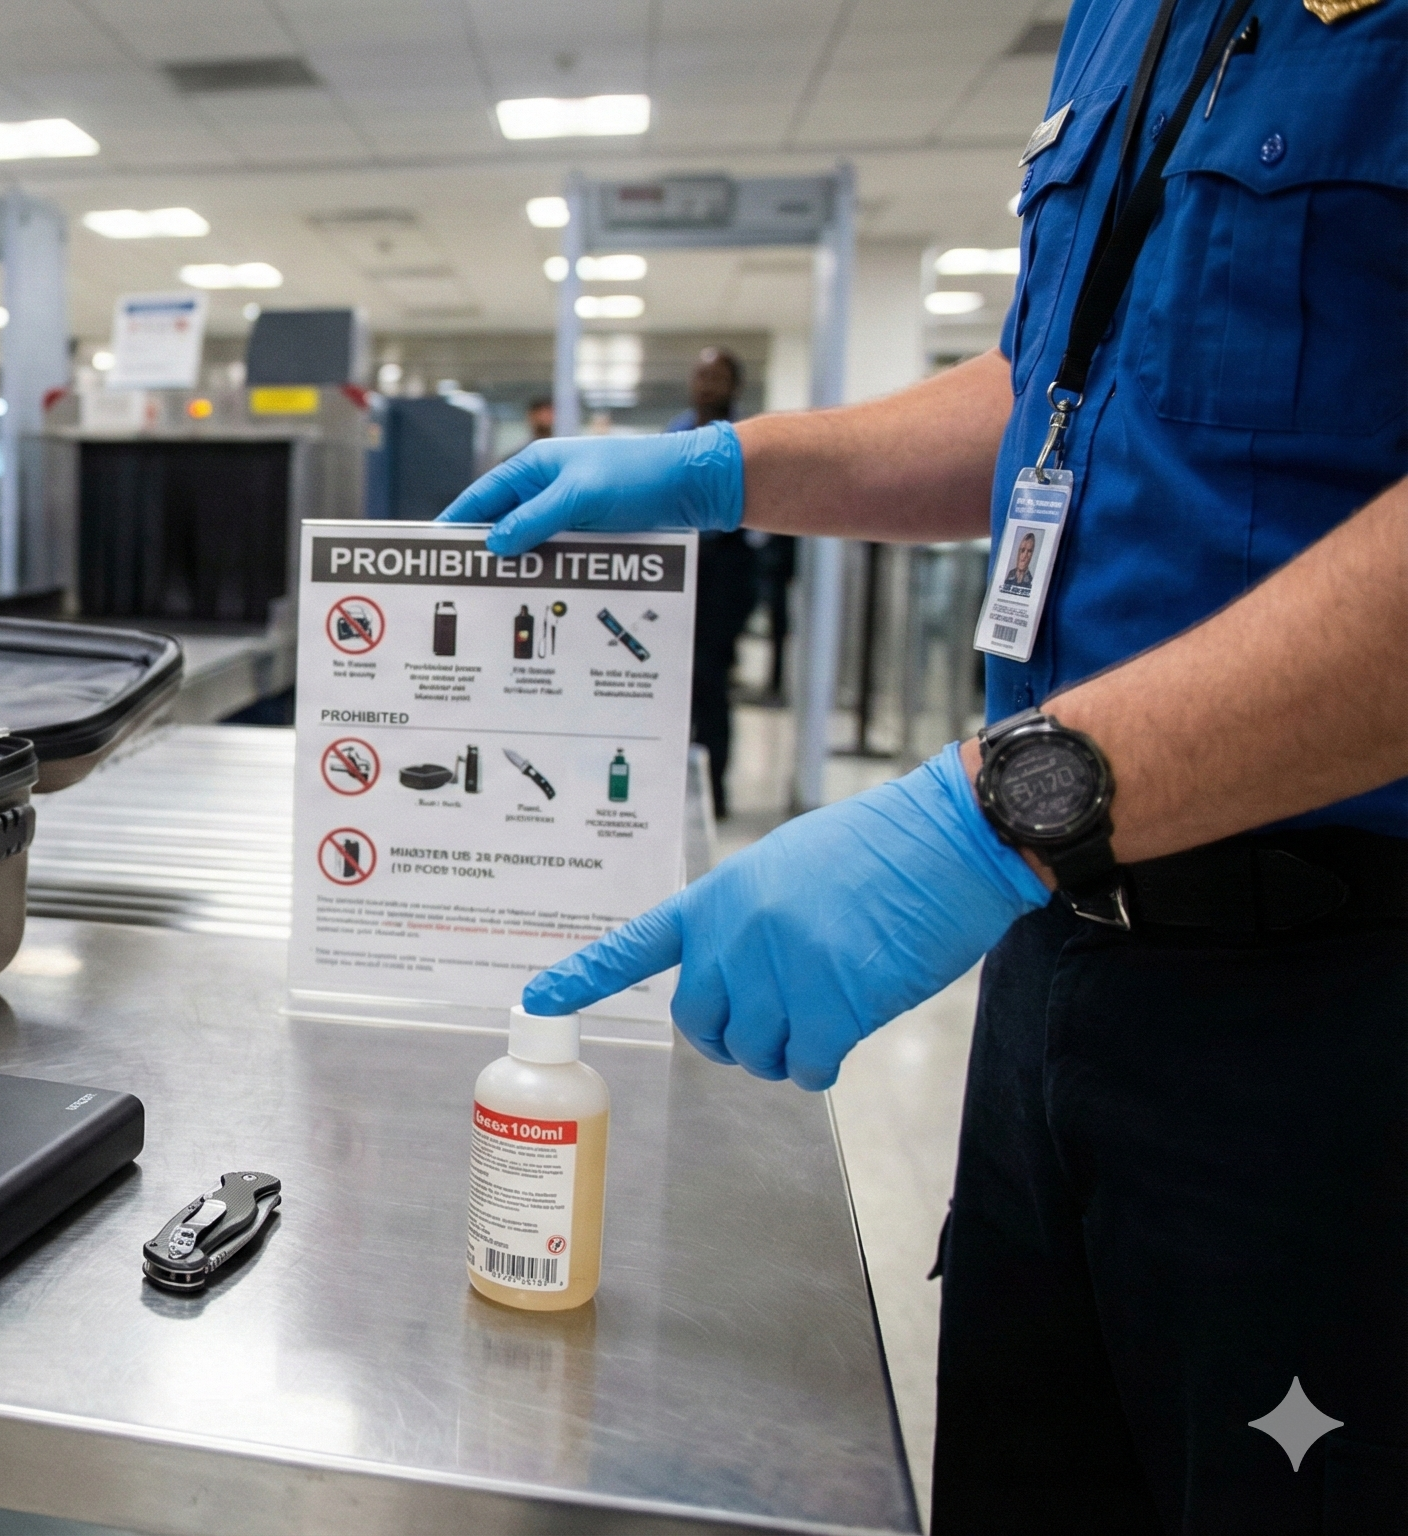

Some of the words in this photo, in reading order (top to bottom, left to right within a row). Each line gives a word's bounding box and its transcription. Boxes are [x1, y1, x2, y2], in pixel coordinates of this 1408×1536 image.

[330, 547, 544, 579] PROHIBITED
[554, 552, 665, 583] ITEMS
[321, 708, 410, 724] PROHIBITED
[511, 1122, 563, 1141] 100ml
